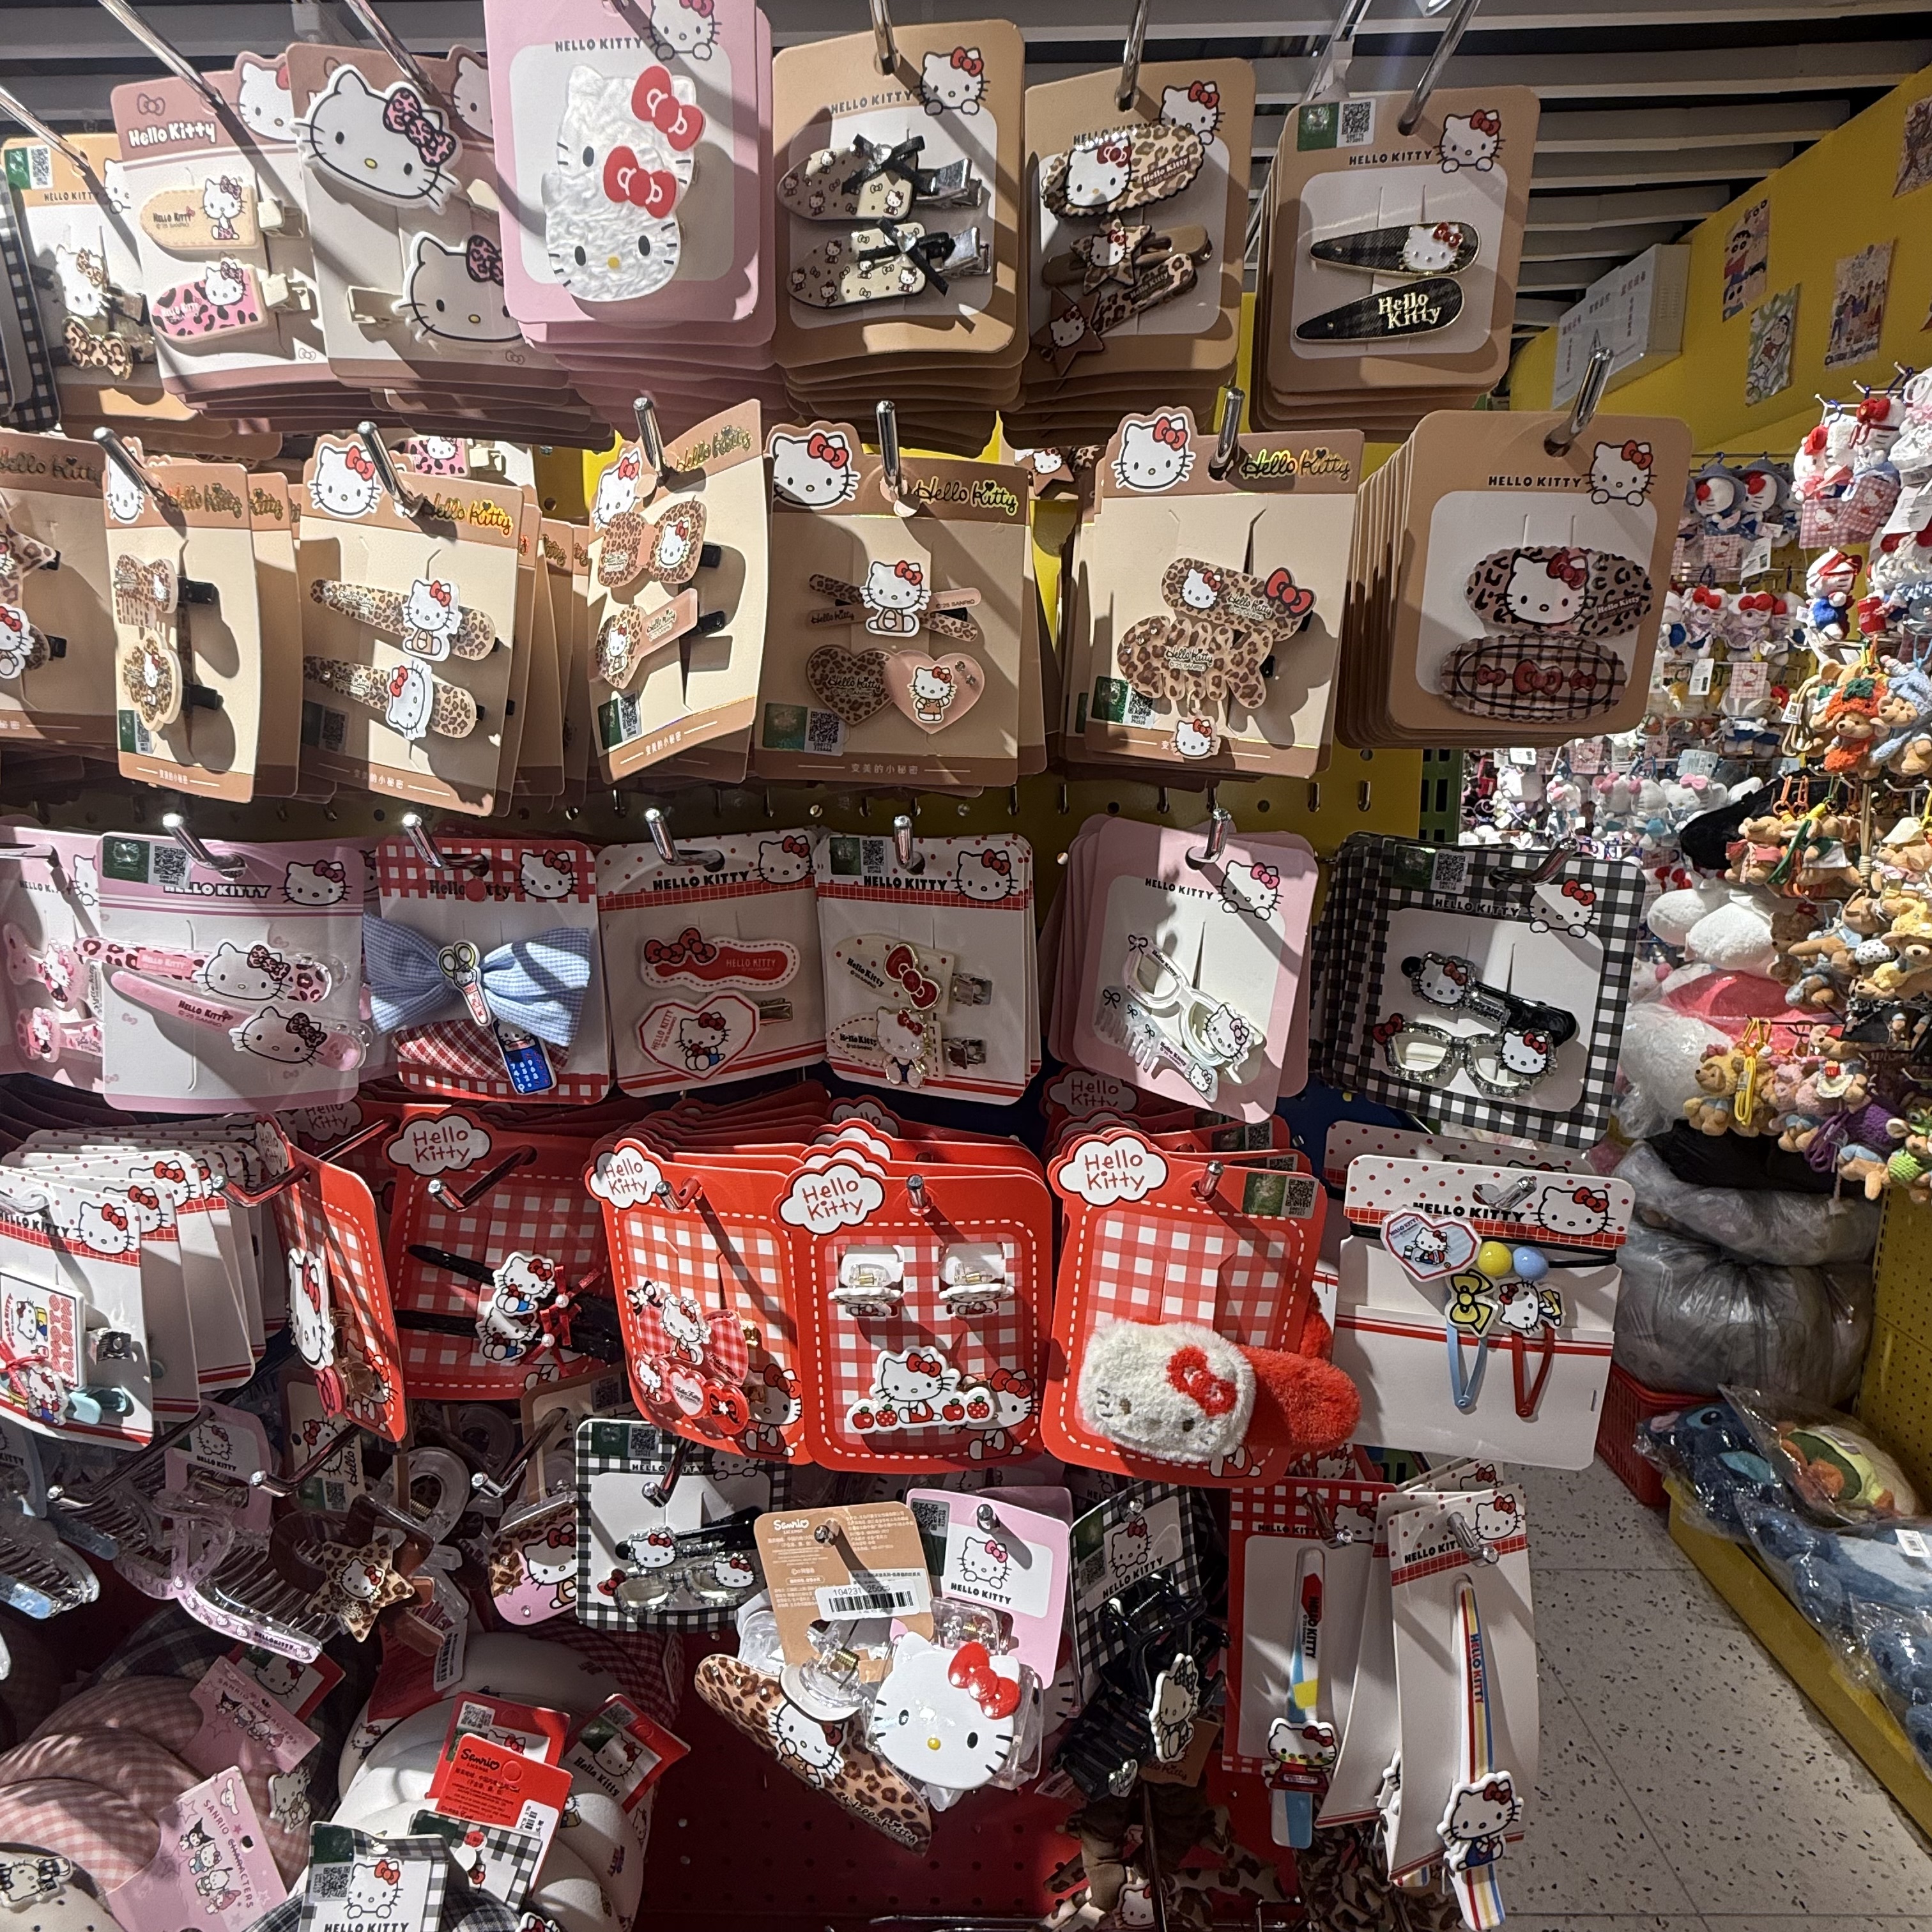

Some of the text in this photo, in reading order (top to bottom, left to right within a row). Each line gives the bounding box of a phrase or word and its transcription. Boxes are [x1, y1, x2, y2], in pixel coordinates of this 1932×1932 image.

[556, 38, 641, 52] HELLO KITTY
[831, 91, 914, 115] HELLO KITTY
[128, 122, 215, 148] Hello Kitty
[1346, 150, 1432, 166] HELLO KITTY
[1142, 158, 1190, 183] Hello Kitty
[44, 194, 68, 202] HELLO
[1378, 292, 1429, 314] Hello
[1388, 307, 1441, 329] Kitty
[1489, 477, 1581, 488] HELLO KITTY
[1598, 595, 1640, 614] Hello Kitty
[852, 763, 918, 775] 变美的小秘密
[429, 880, 465, 895] Hello
[653, 871, 749, 891] HELLO KITTY
[864, 876, 947, 891] HELLO KITTY
[1145, 878, 1214, 900] HELLO KITTY
[216, 885, 271, 898] KITTY
[1435, 898, 1520, 917] HELLO KITTY
[753, 958, 776, 967] KITTY
[847, 958, 865, 974] Hello
[864, 969, 884, 988] Kitty
[178, 1000, 202, 1015] HELLO
[651, 1029, 665, 1050] HELLO
[660, 1009, 674, 1029] KITTY
[1071, 1078, 1119, 1094] Hello
[309, 1116, 348, 1130] Kitty
[413, 1126, 469, 1147] Hello
[415, 1145, 471, 1163] Kitty
[1085, 1150, 1142, 1171] Hello
[604, 1158, 643, 1179] Hello
[608, 1177, 648, 1195] Kitty
[802, 1177, 859, 1203] Hello
[1087, 1171, 1144, 1192] Kitty
[807, 1198, 862, 1221] Kitty
[1413, 1202, 1526, 1222] HELLO KITTY
[33, 1218, 70, 1238] KITTY
[216, 1460, 236, 1472] KITTY
[632, 1464, 666, 1473] HELLO
[1404, 1546, 1436, 1565] HELLO
[1103, 1556, 1163, 1598] HELLO KITTY
[833, 1587, 862, 1597] 104231
[951, 1583, 1012, 1605] HELLO KITTY
[1305, 1628, 1318, 1659] KITTY
[1471, 1632, 1483, 1703] HELLO KITTY
[573, 1756, 621, 1798] Hello Kitty
[203, 1798, 255, 1908] SANRIO CHARACTERS
